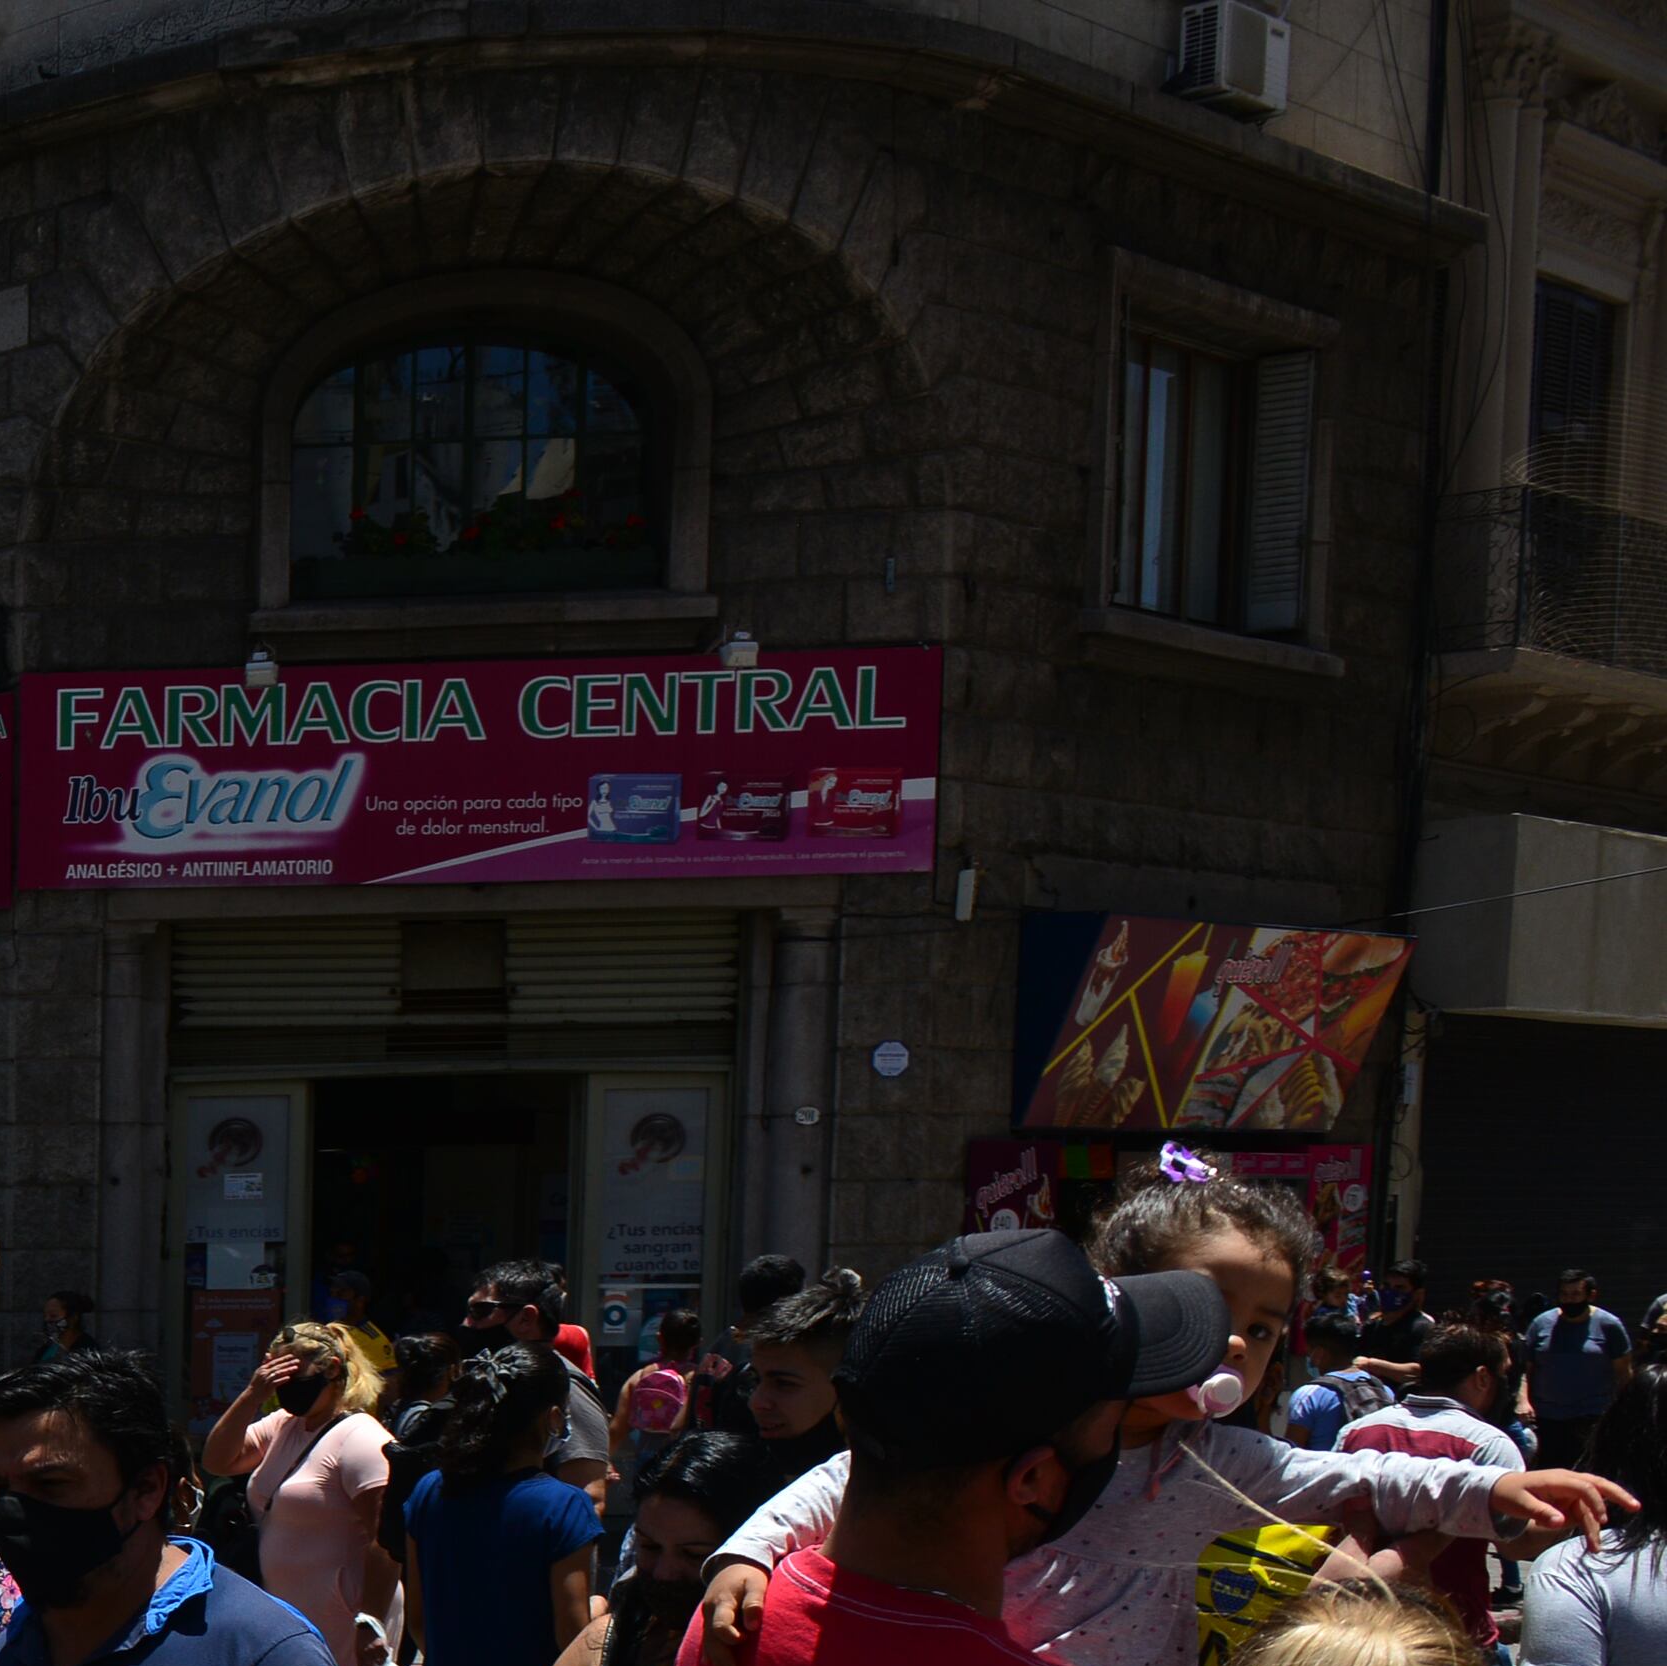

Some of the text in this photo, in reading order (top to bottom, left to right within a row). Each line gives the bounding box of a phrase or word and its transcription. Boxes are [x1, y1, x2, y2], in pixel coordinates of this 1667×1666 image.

[55, 665, 907, 751] FARMACIA CENTRAL
[365, 792, 583, 815] Una opción para cada tipo
[395, 815, 550, 836] de dolor menstrual.
[66, 859, 163, 880] ANALGÉSICO
[181, 858, 334, 877] ANTIINFLAMATORIO
[188, 1225, 224, 1241] ¿Tus
[607, 1223, 646, 1239] ¿Tus
[623, 1242, 693, 1257] sangran
[614, 1258, 700, 1272] cuando te
